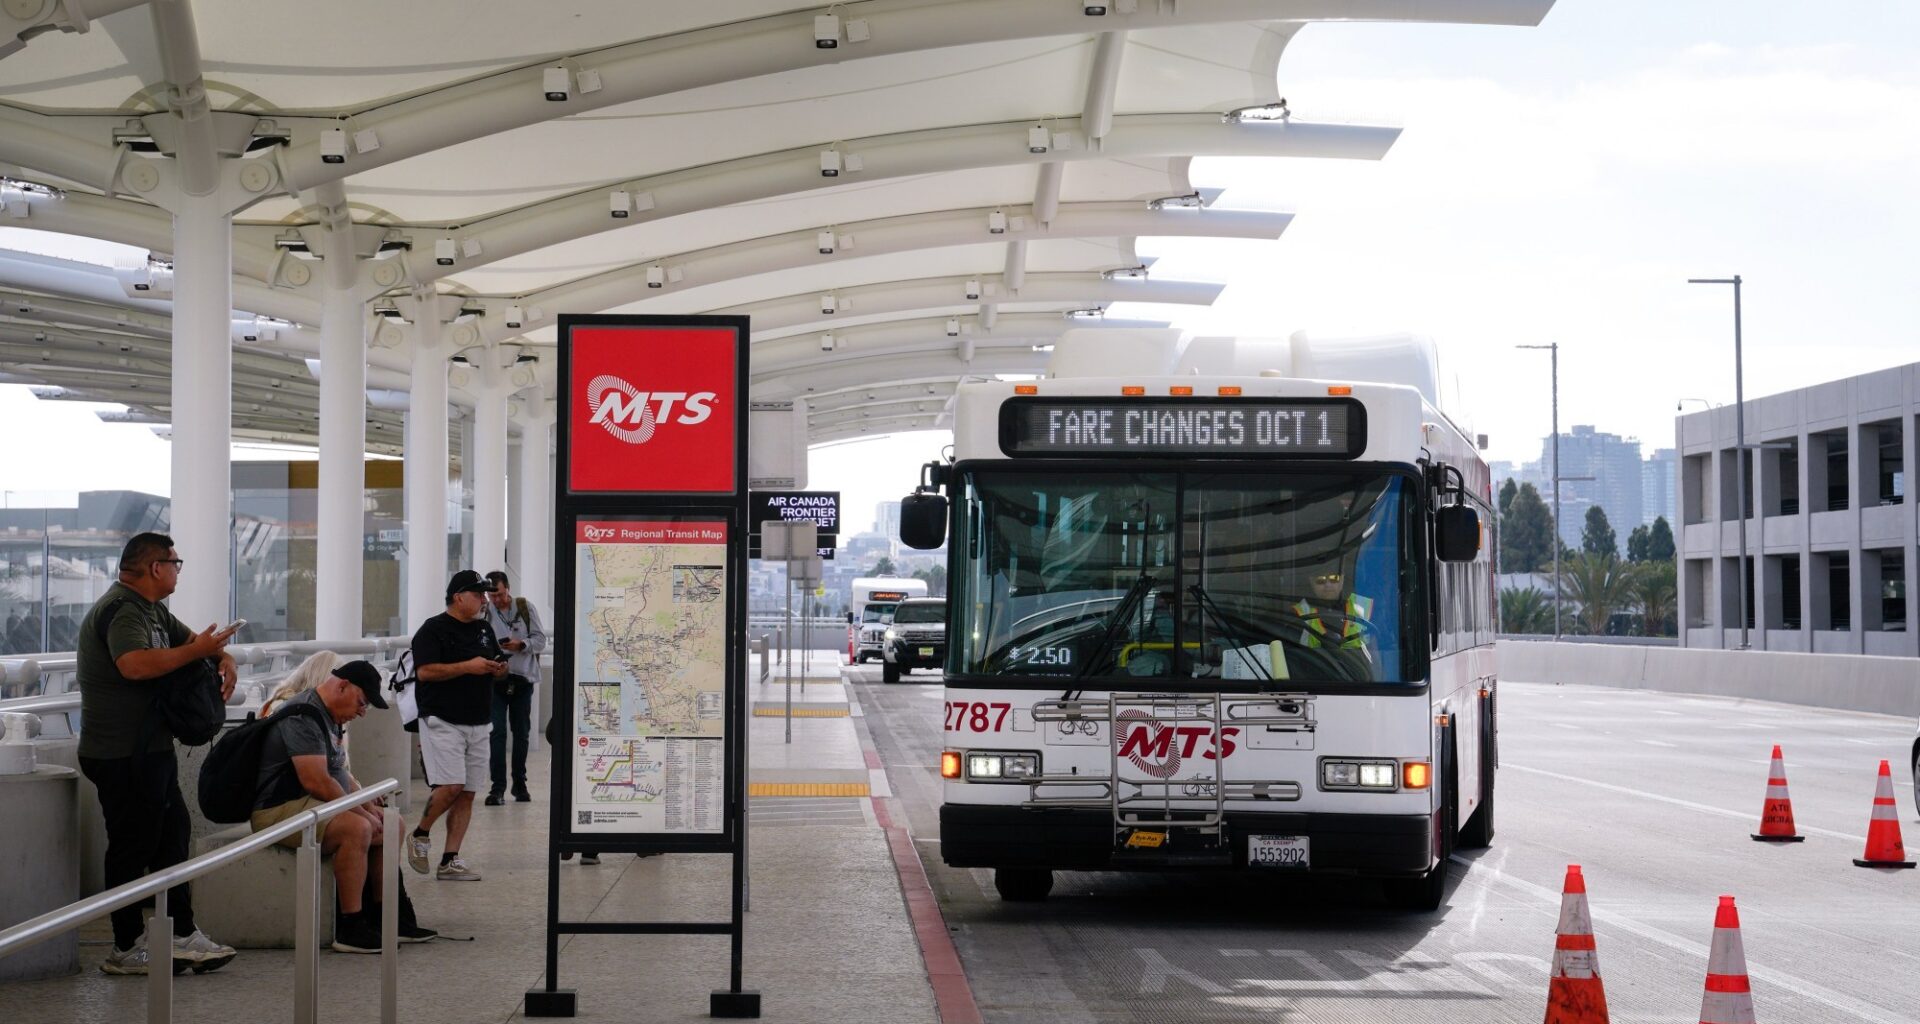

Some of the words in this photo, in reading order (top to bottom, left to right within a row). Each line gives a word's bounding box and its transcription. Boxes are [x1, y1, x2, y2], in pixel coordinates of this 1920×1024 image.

[589, 391, 717, 425] MTS
[1048, 409, 1113, 445] FARE
[1125, 409, 1246, 445] CHANGES
[1256, 409, 1305, 446] OCT
[1317, 409, 1332, 445] 1
[768, 496, 787, 506] AIR
[789, 496, 836, 506] CANADA
[780, 507, 836, 517] FRONTIER
[585, 528, 615, 537] MTS
[621, 529, 664, 540] Regional
[667, 529, 699, 539] Transit
[702, 530, 723, 540] Map
[1008, 646, 1020, 660] $
[1027, 647, 1071, 665] 2.50
[944, 702, 1011, 733] 2787
[1118, 727, 1240, 760] MTS
[1253, 847, 1305, 862] 1553902
